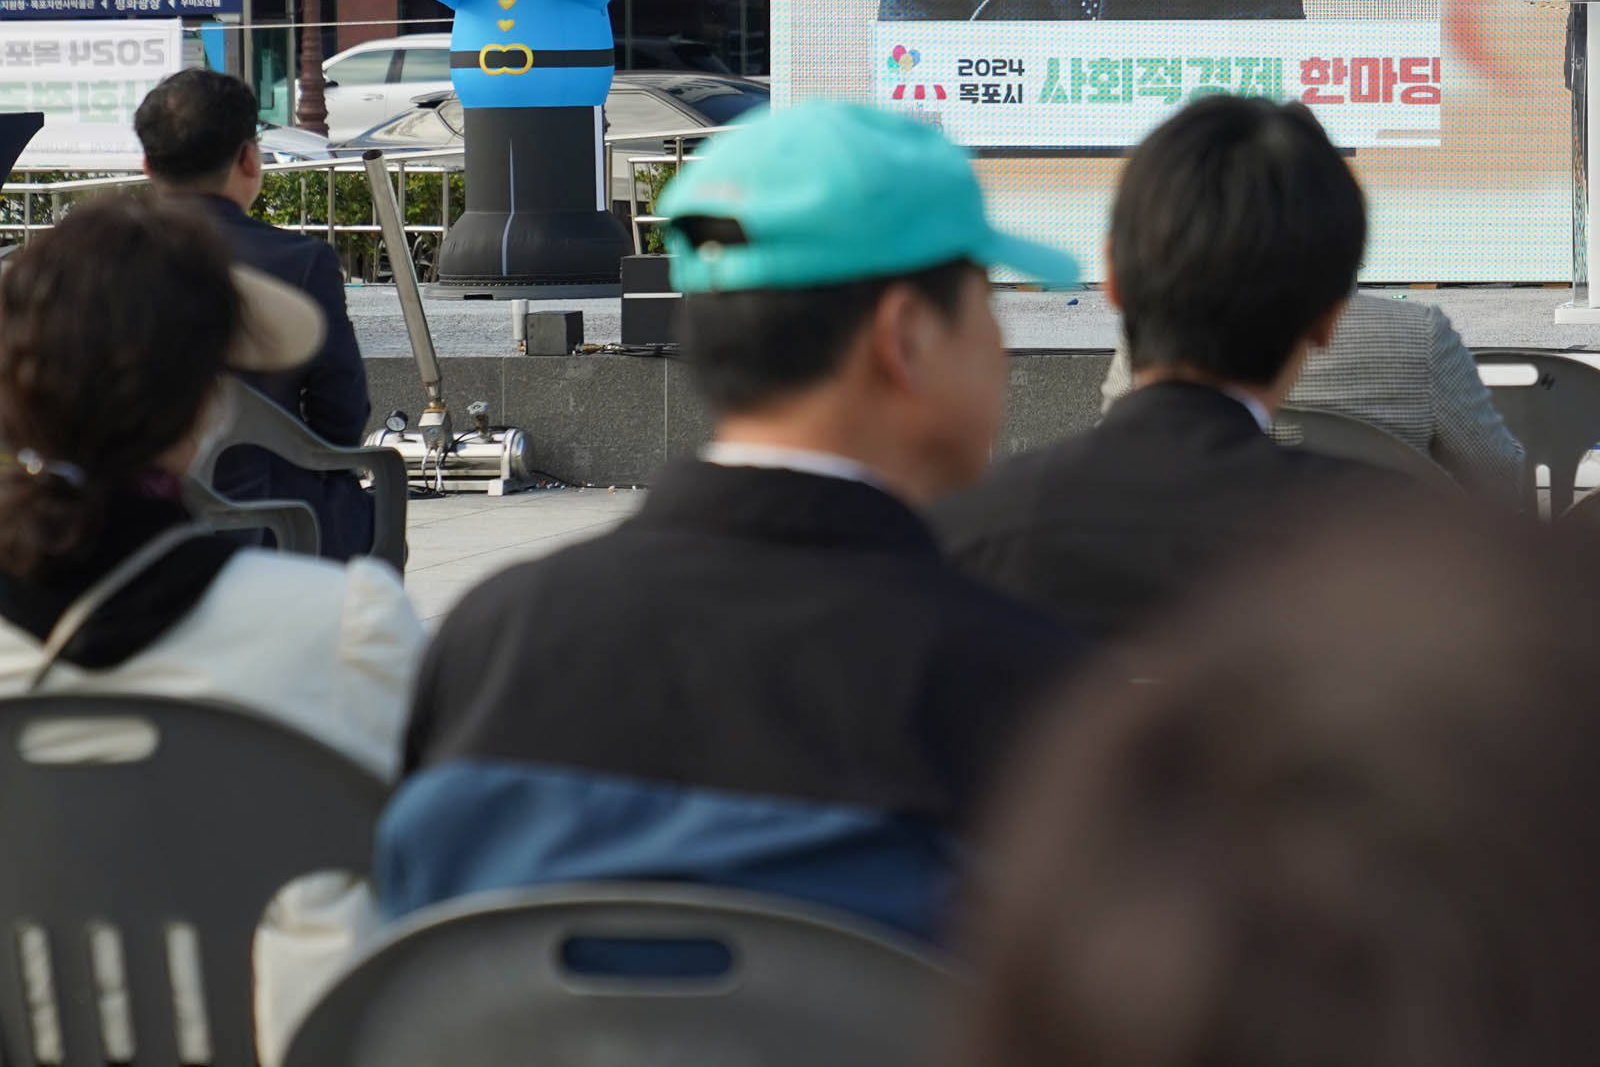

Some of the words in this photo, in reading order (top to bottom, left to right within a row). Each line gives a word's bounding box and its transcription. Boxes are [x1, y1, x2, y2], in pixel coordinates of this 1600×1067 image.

[957, 58, 1025, 77] 2024
[1038, 56, 1284, 105] 사회적경제
[959, 82, 1024, 104] 목포시
